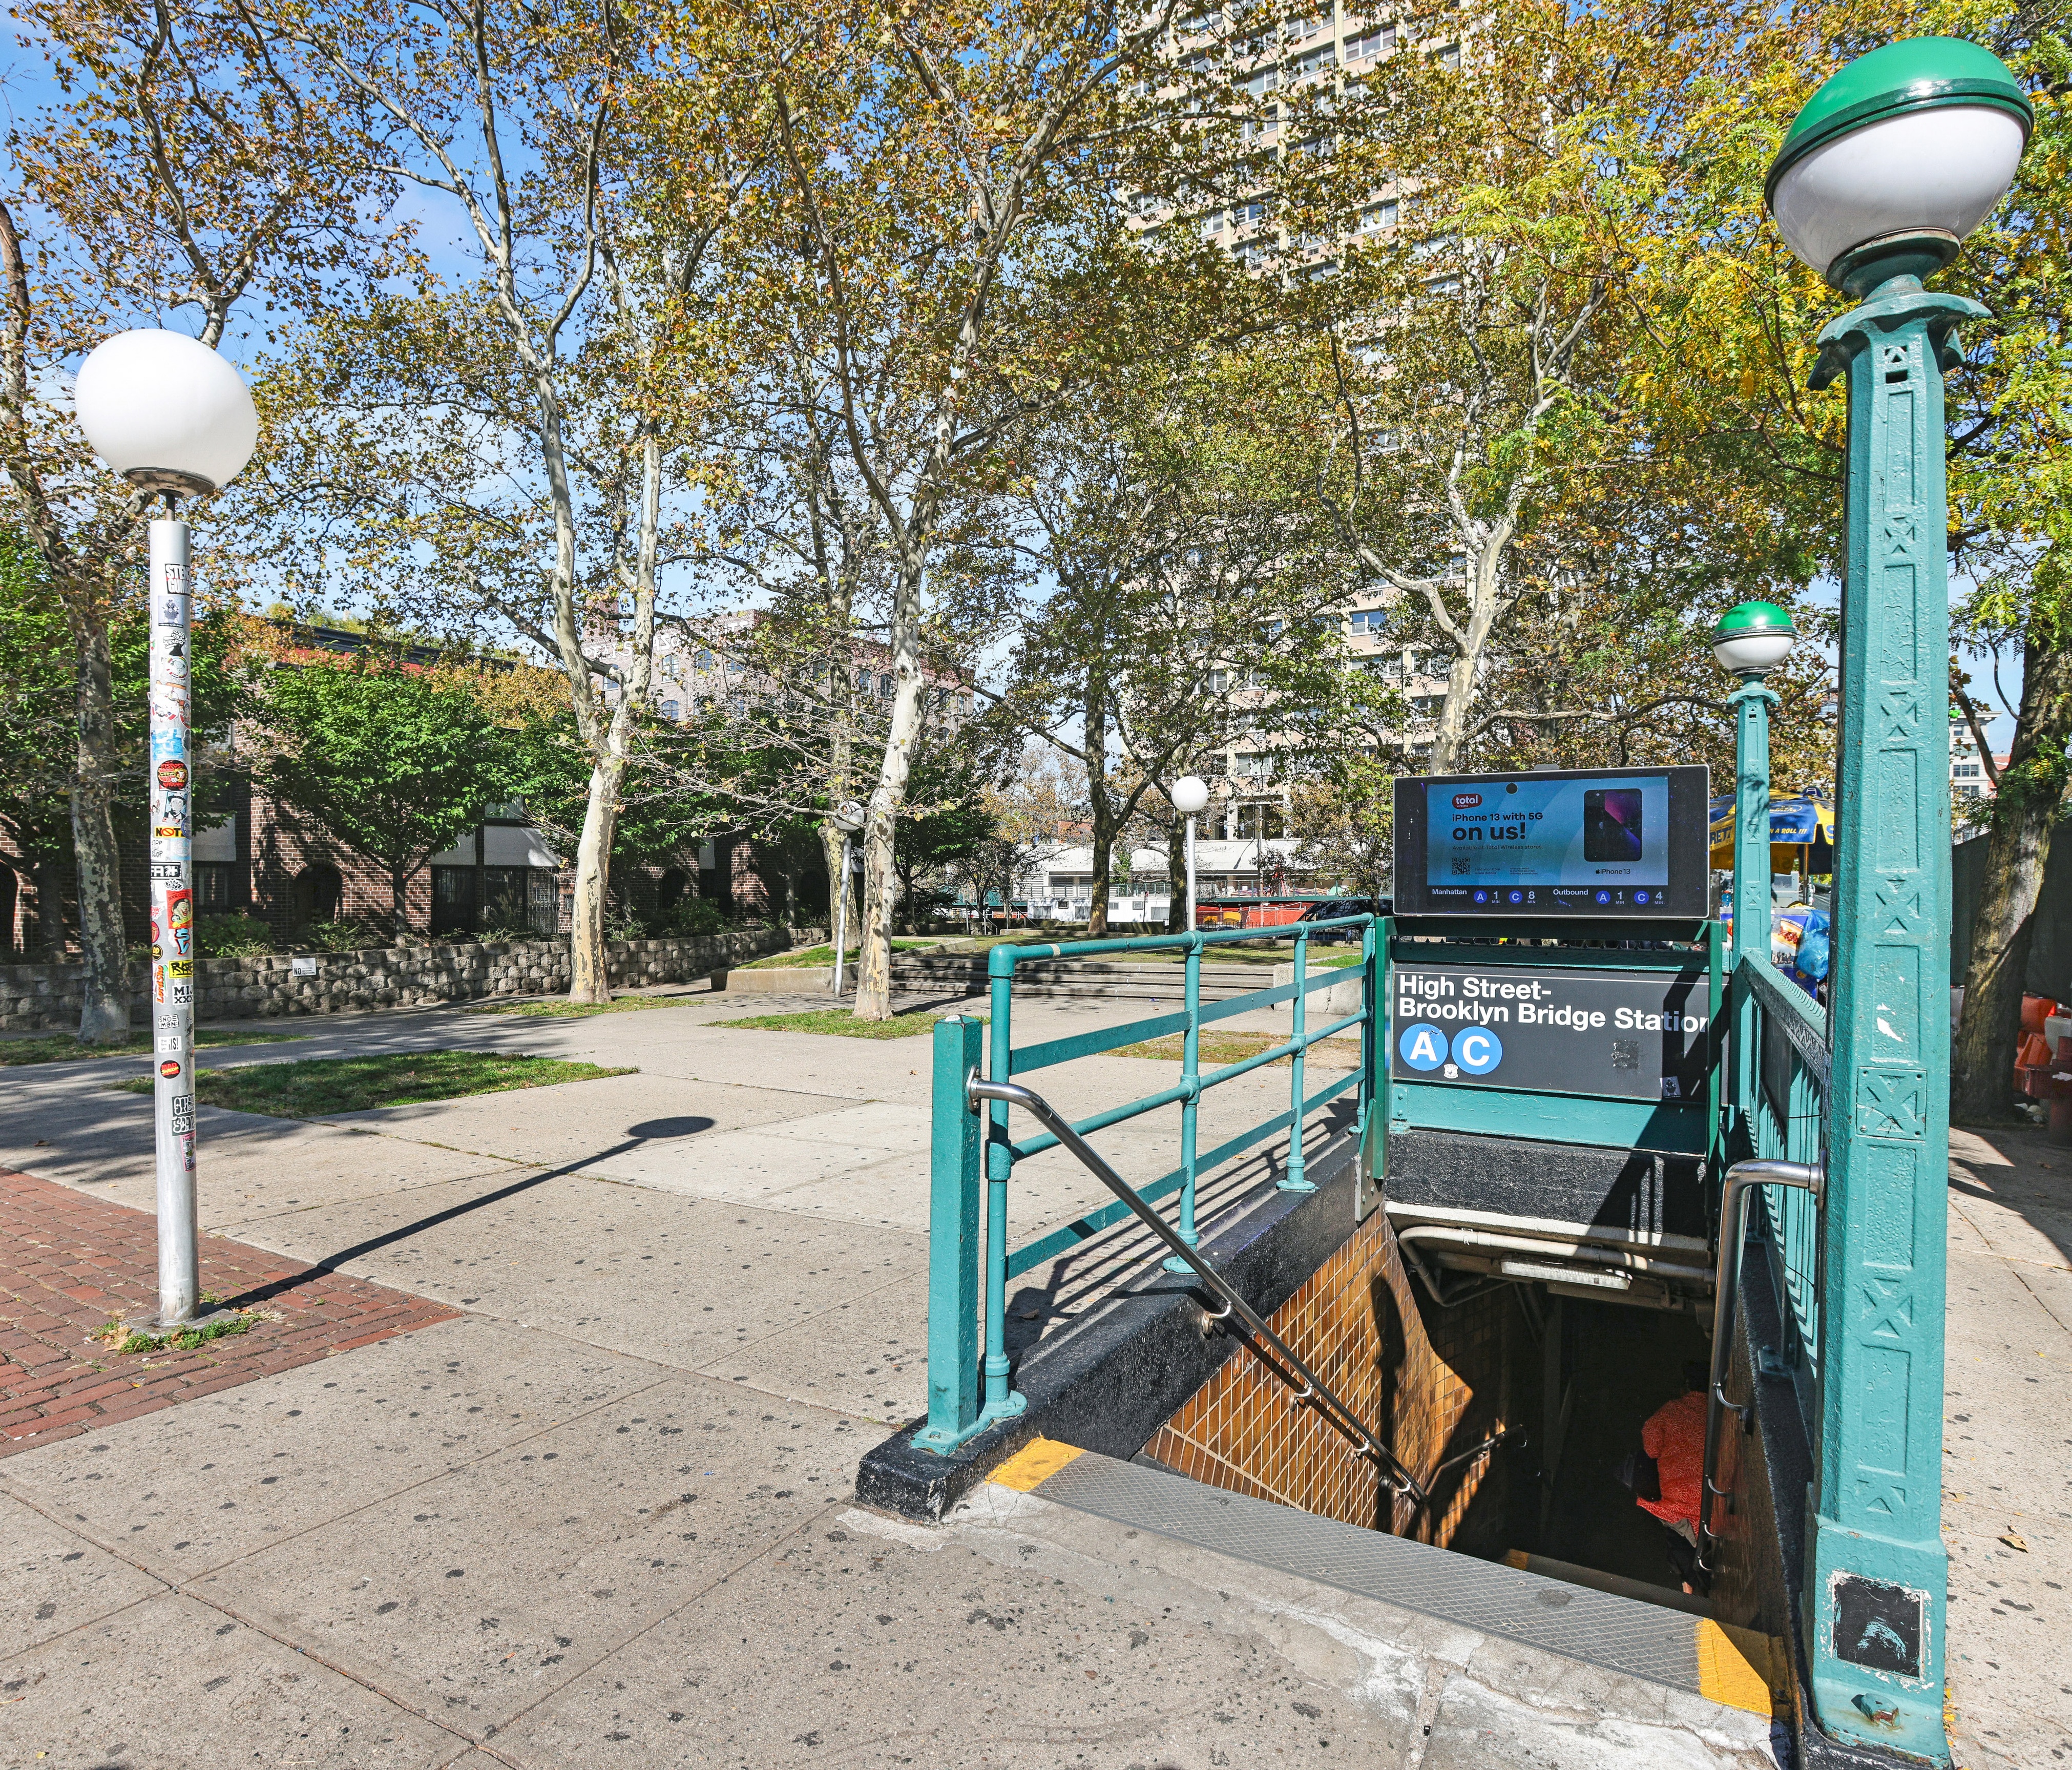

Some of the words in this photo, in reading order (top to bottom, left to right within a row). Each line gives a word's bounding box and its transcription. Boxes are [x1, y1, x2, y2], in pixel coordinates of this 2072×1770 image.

[1456, 795, 1478, 804] total
[1452, 814, 1488, 822] iPhone
[1503, 812, 1525, 821] with
[1529, 812, 1543, 820] 5G
[1452, 826, 1482, 841] on
[1490, 822, 1526, 840] us!
[1493, 891, 1498, 899] 1
[1529, 891, 1535, 900] 8
[1617, 891, 1622, 900] 1
[1637, 893, 1645, 902] C
[1656, 891, 1663, 900] 4
[1399, 974, 1455, 1000] High
[1462, 977, 1552, 1000] Street-
[1399, 997, 1509, 1025] Brooklyn
[1518, 1003, 1606, 1031] Bridge
[1409, 1031, 1437, 1061] A
[1462, 1035, 1490, 1066] C
